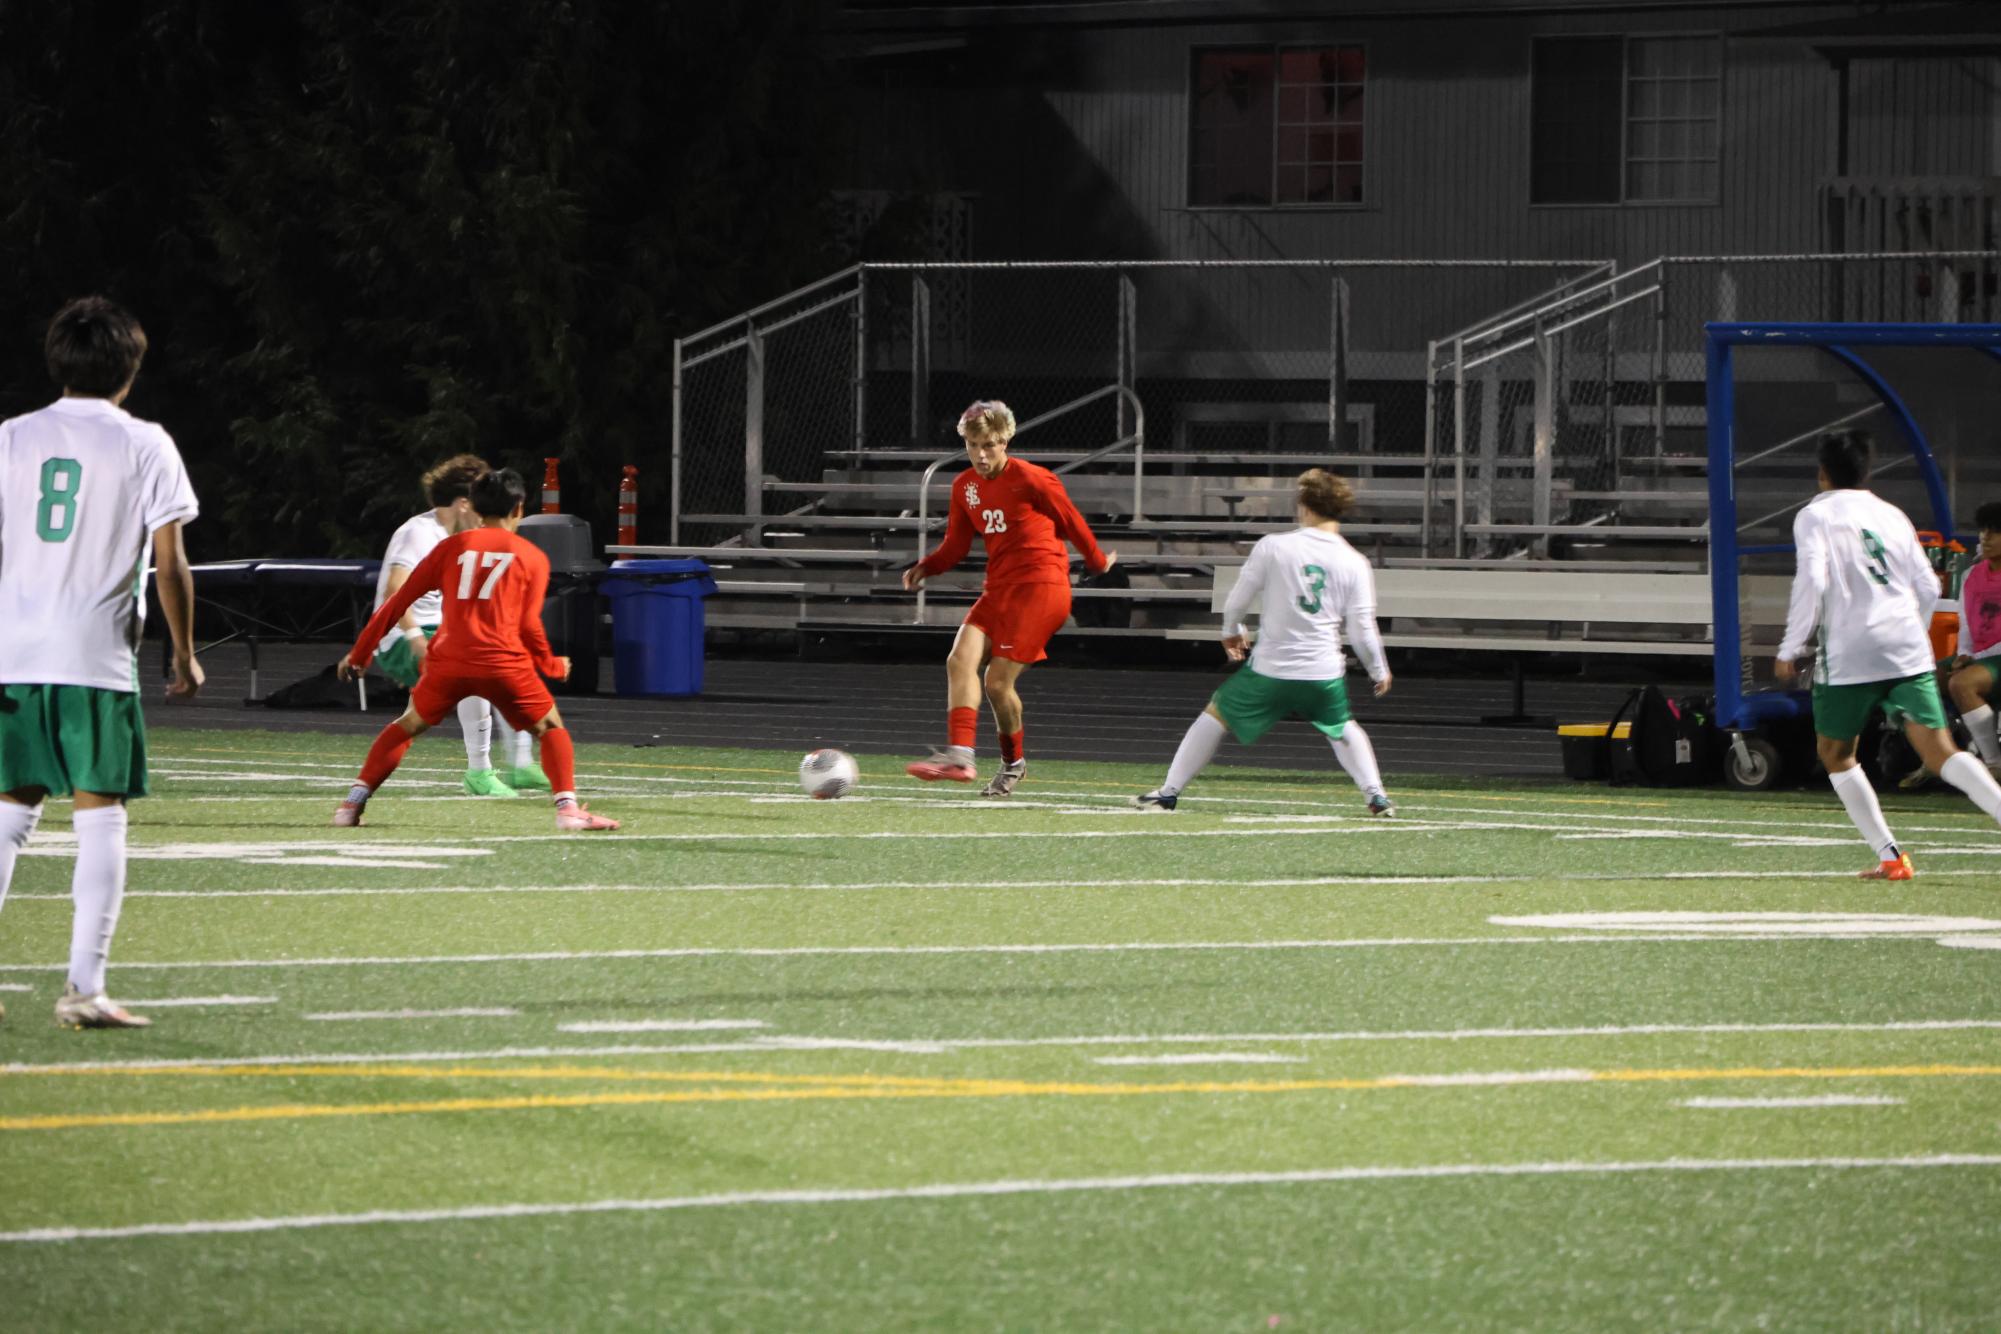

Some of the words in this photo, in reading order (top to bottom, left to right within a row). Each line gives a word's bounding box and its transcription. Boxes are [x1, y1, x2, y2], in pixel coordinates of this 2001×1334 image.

[36, 457, 82, 543] 8
[982, 509, 1008, 534] 23
[457, 549, 515, 600] 17
[1861, 528, 1889, 585] 9
[1298, 564, 1326, 614] 3
